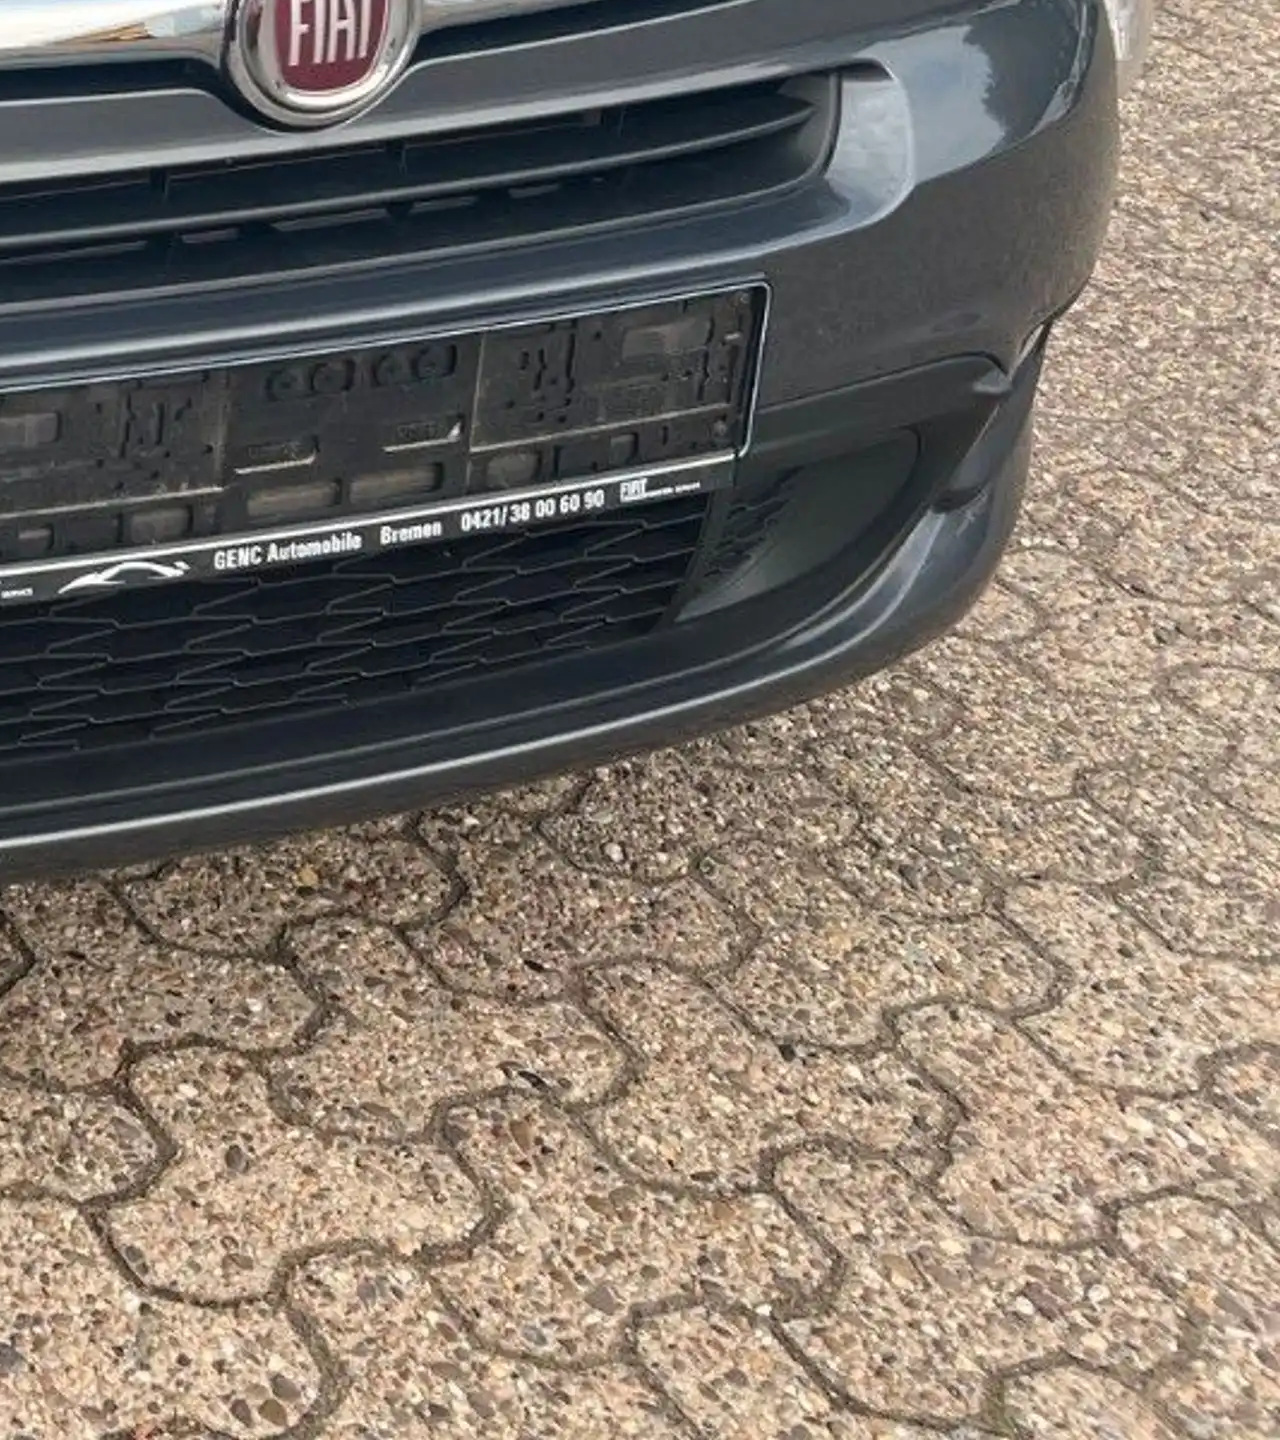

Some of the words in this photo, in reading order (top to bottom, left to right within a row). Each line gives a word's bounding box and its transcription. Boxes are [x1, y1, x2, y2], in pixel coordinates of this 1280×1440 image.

[215, 546, 261, 570] GENC
[268, 532, 362, 562] Automobile
[380, 520, 442, 546] Bremen
[535, 497, 556, 518] 00
[560, 493, 580, 514] 60
[584, 489, 605, 509] 90
